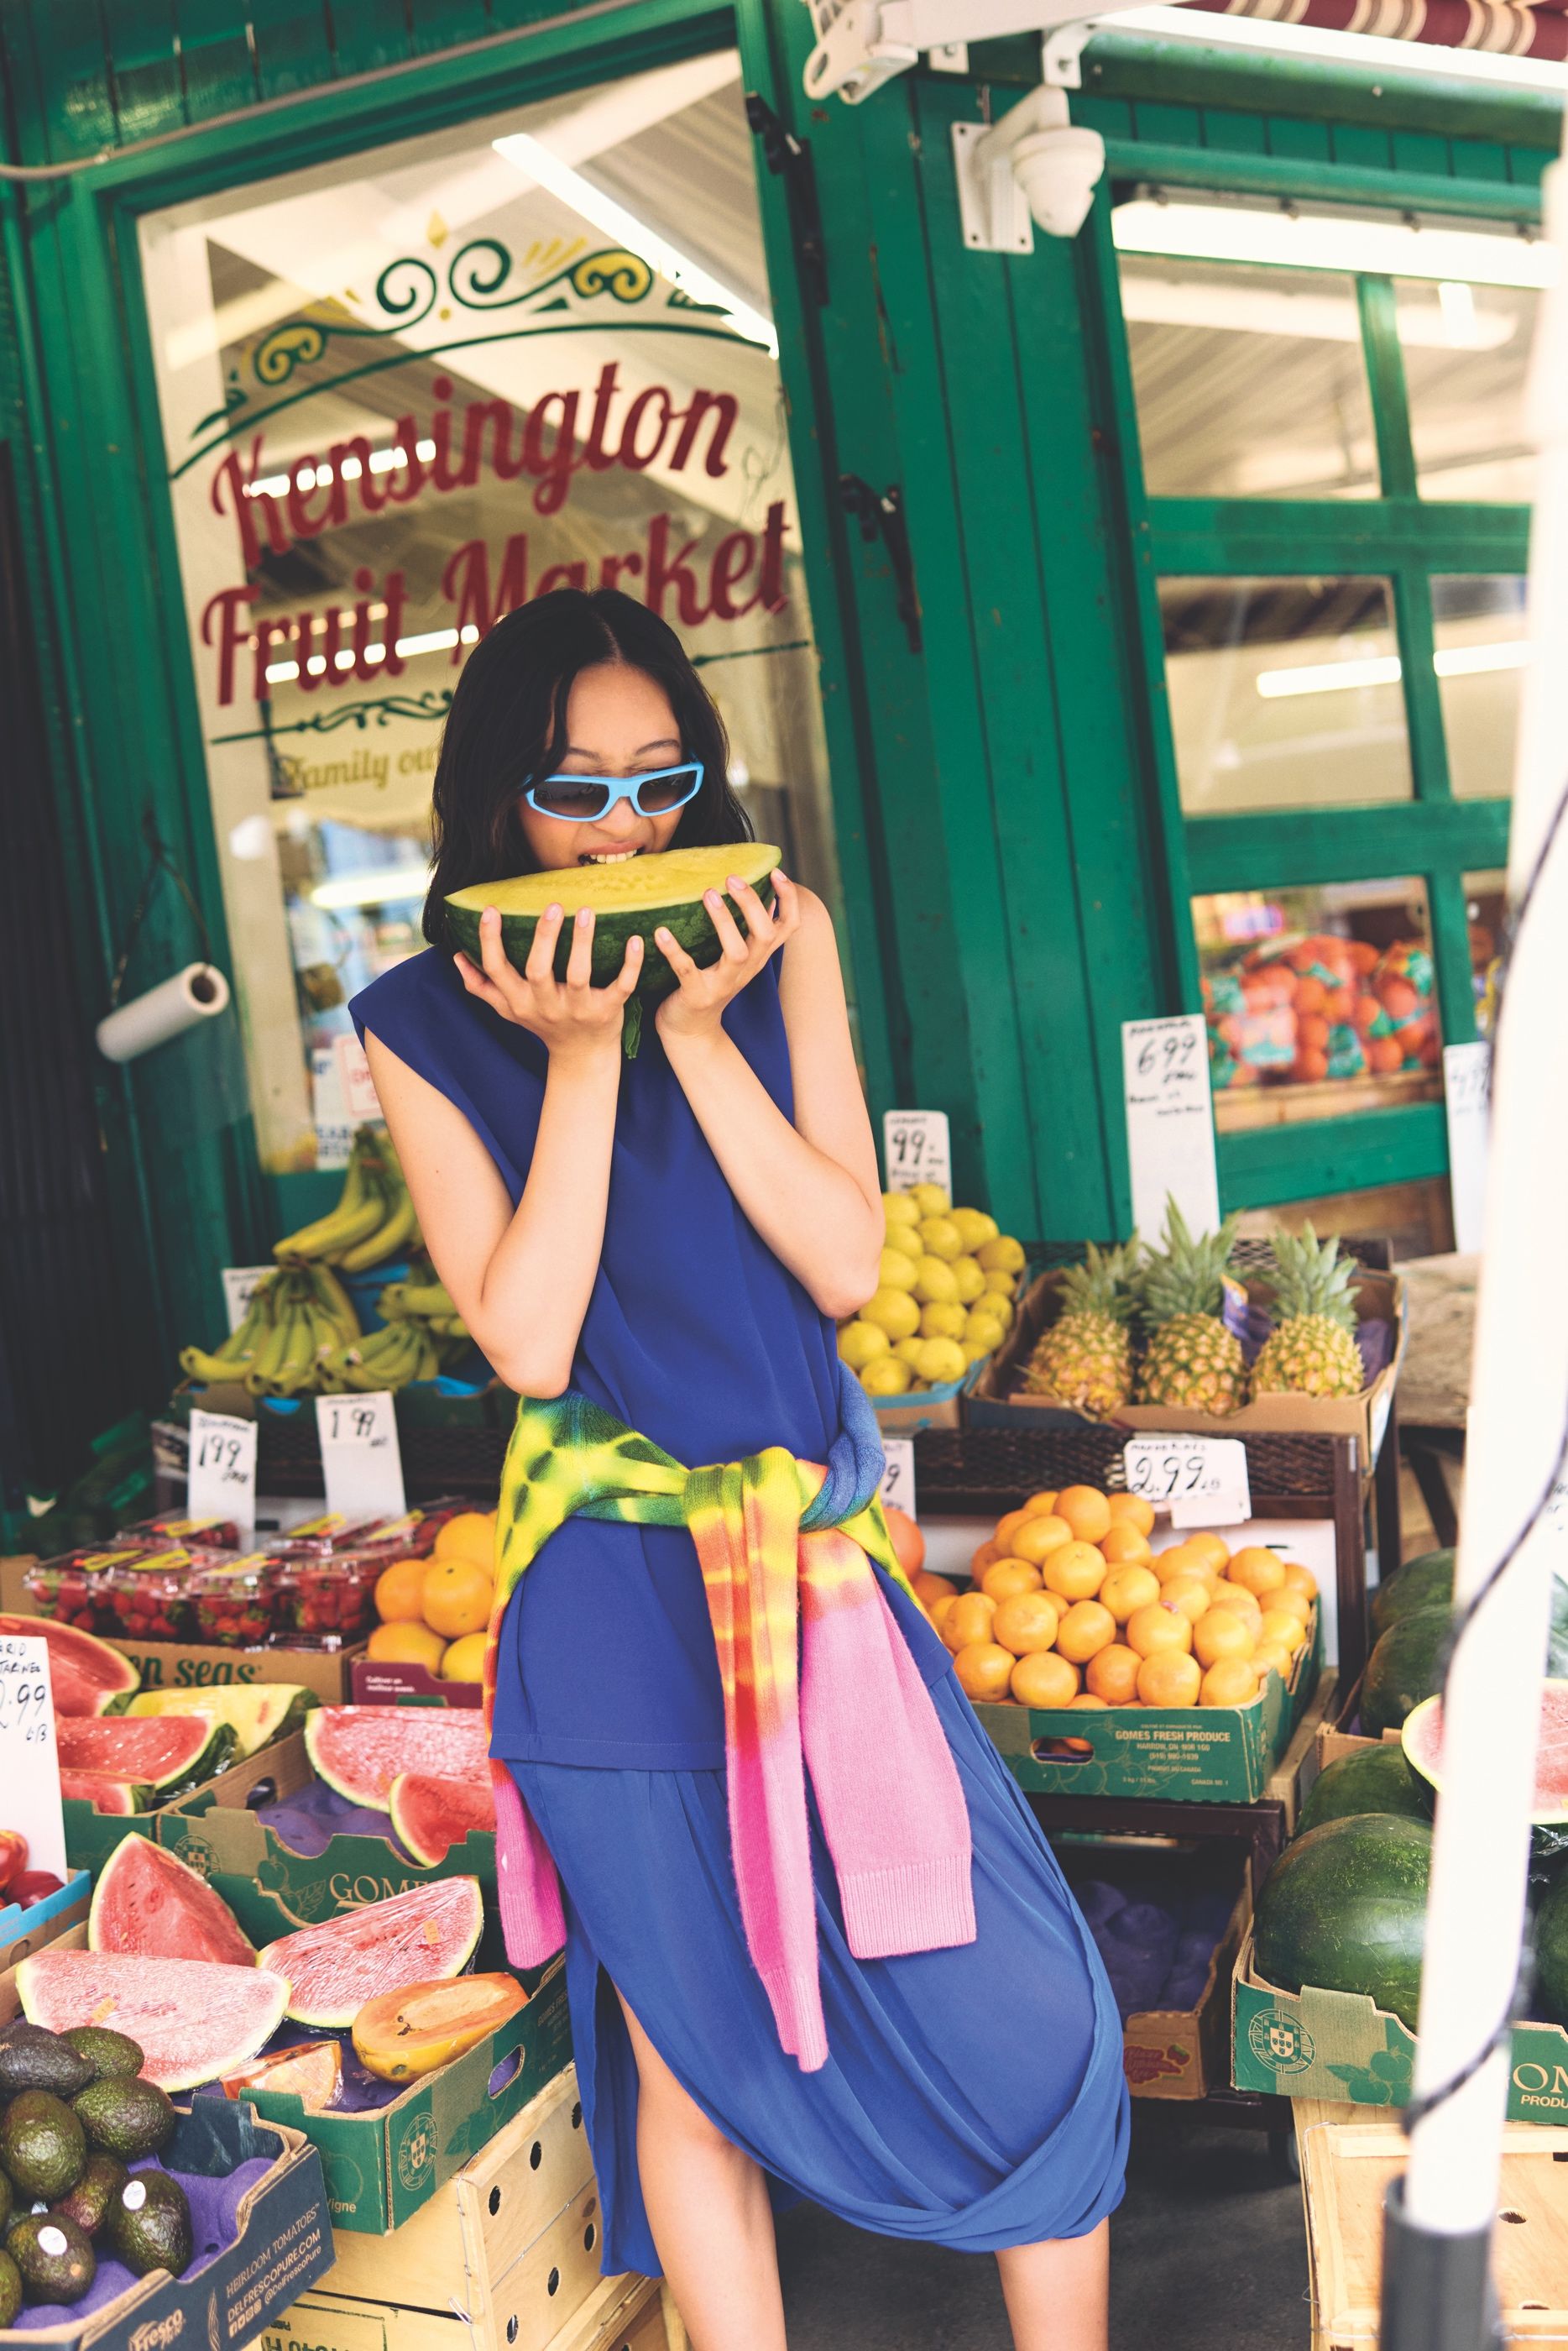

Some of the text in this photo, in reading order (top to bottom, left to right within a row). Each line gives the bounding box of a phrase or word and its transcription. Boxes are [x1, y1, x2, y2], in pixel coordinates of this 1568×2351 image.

[212, 361, 739, 570] Kensington
[201, 566, 409, 708] Fruit
[281, 749, 389, 791] Family
[1131, 1455, 1205, 1495] 2.99
[1116, 1730, 1231, 1742] GOMES FRESH PRODUCE
[329, 1873, 429, 1903] GOM
[226, 2247, 271, 2300] HEIRLOOM
[227, 2228, 321, 2323] DELFRESCOPURE.COM
[264, 2245, 321, 2306] @DelFrescoPure
